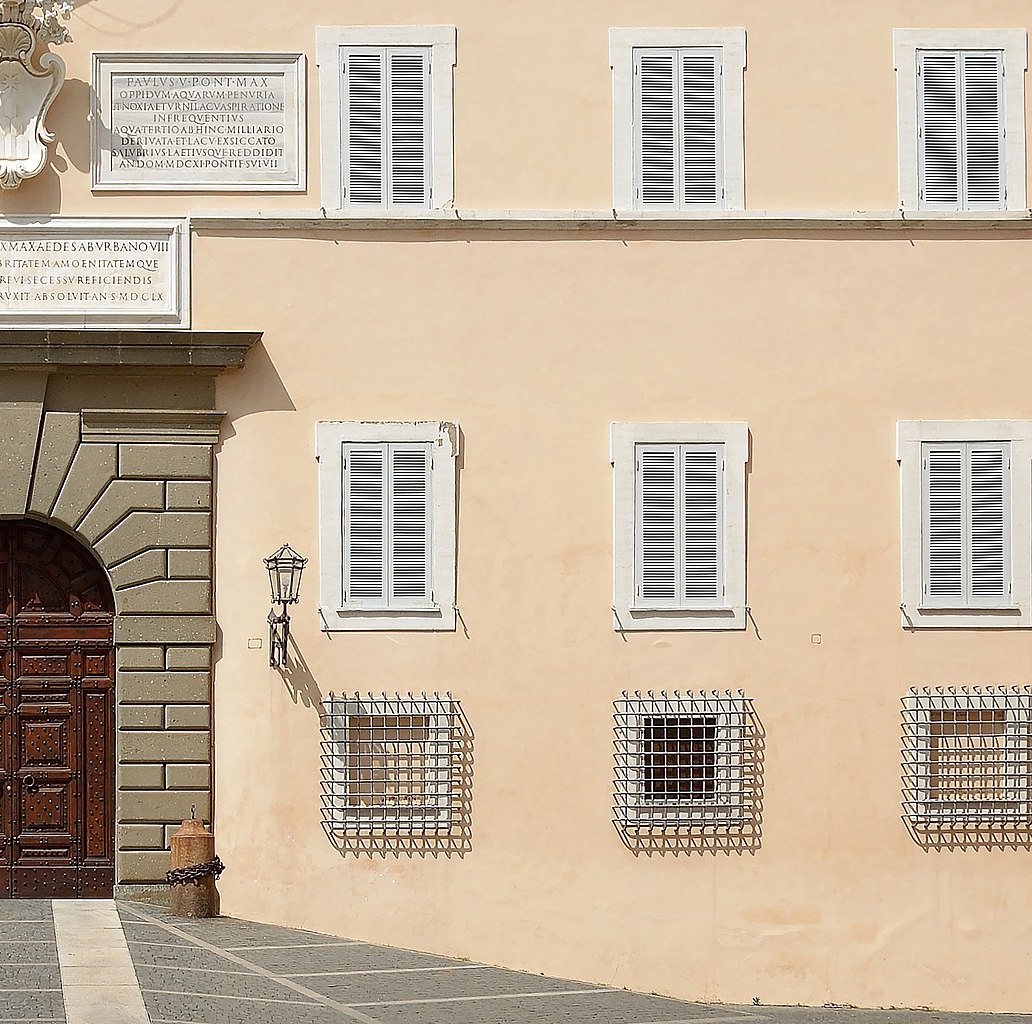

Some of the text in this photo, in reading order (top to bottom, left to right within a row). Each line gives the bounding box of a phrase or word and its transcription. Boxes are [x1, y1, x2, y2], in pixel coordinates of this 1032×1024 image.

[128, 78, 174, 86] PAVLVS
[193, 78, 232, 86] PONT
[237, 78, 268, 86] MAX
[120, 90, 274, 102] OPPIDVM AQVARVM PENVRIA
[154, 114, 244, 124] INFREQVENTIVS
[114, 126, 141, 136] AQVA
[142, 126, 179, 134] TERTIO
[228, 126, 284, 134] MILLIARIO
[122, 137, 276, 145] DERIVATA ET LACV EXSICCATO
[168, 148, 228, 159] LAETIVSQVE
[263, 160, 278, 168] VII
[9, 242, 36, 251] MAX
[37, 242, 77, 251] AEDES
[78, 242, 94, 251] AB
[95, 242, 148, 251] VRBANO
[150, 242, 168, 251] VIII
[27, 276, 74, 284] SECESSV
[77, 276, 152, 284] REFICIENDIS
[34, 292, 90, 300] ABSOLVIT
